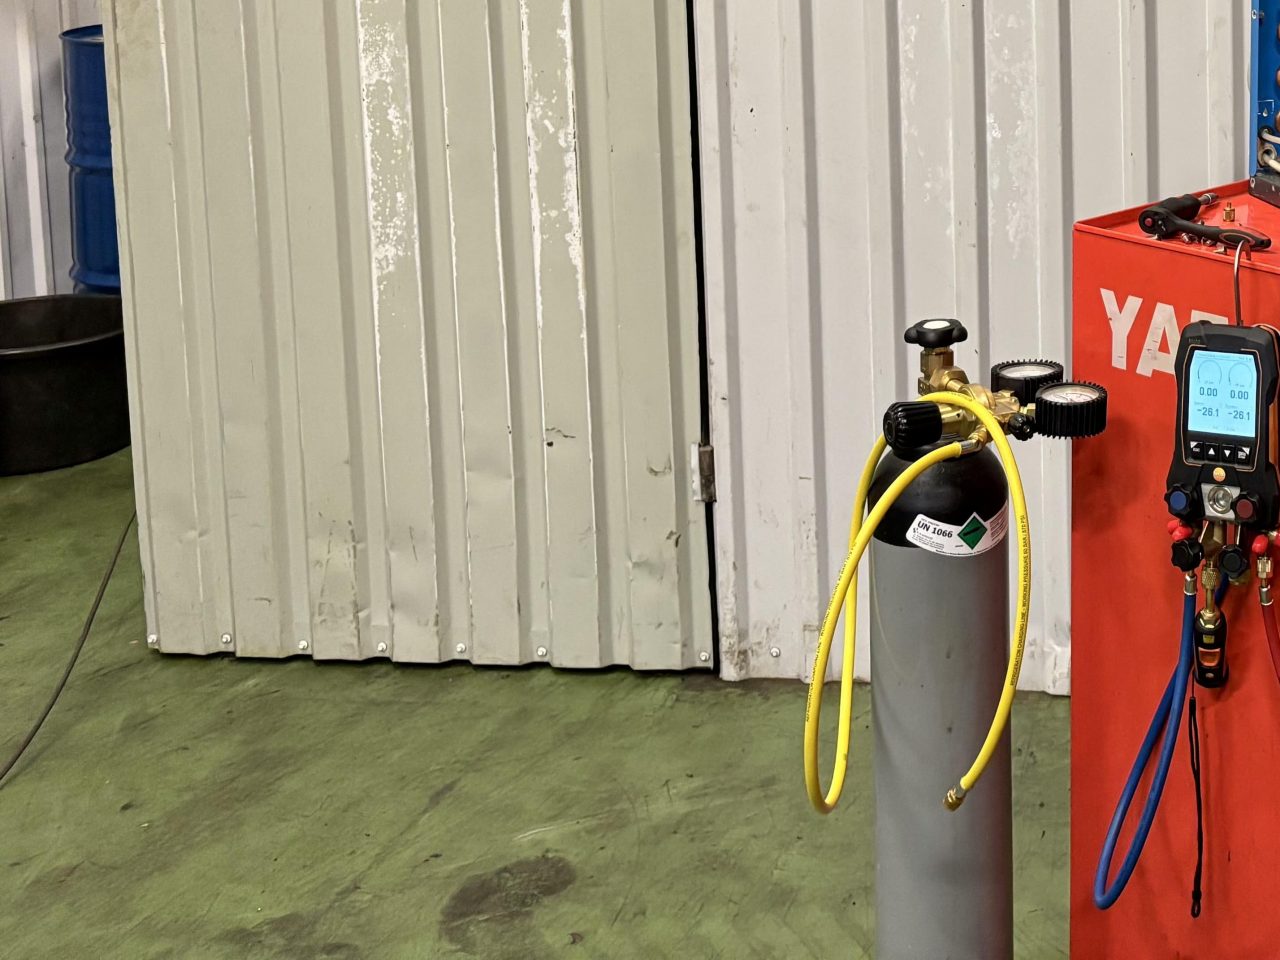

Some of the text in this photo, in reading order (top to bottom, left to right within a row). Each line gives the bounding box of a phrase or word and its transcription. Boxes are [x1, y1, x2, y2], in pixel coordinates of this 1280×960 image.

[1199, 386, 1218, 397] 0.00
[1230, 389, 1249, 400] 0.00
[1197, 406, 1219, 417] -26.1
[1228, 410, 1250, 421] -26.1
[917, 521, 930, 532] UN
[932, 526, 953, 538] 1066
